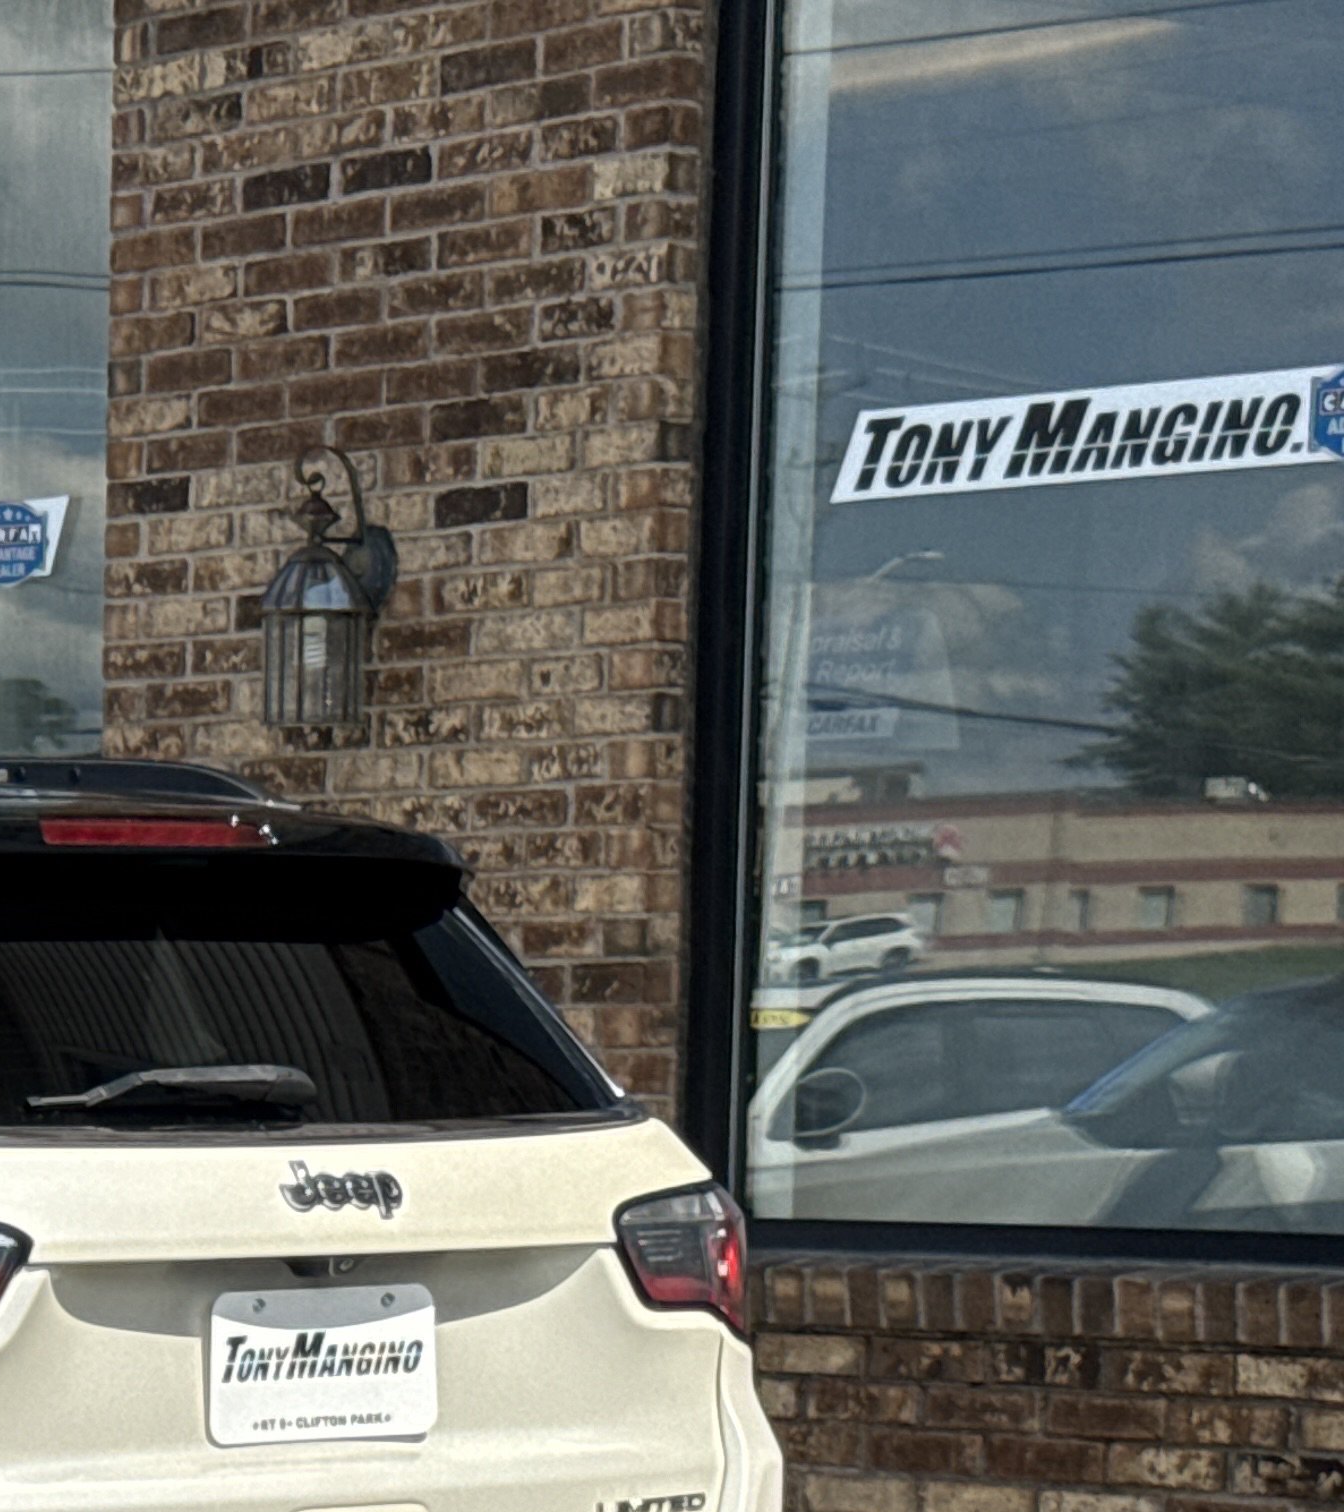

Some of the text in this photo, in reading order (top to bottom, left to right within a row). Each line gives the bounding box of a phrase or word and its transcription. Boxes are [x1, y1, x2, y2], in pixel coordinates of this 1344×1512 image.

[853, 415, 1015, 492] TONY
[278, 1159, 404, 1220] Jeep
[221, 1330, 424, 1383] TONY MANGINO
[295, 1415, 347, 1429] CLIFTON
